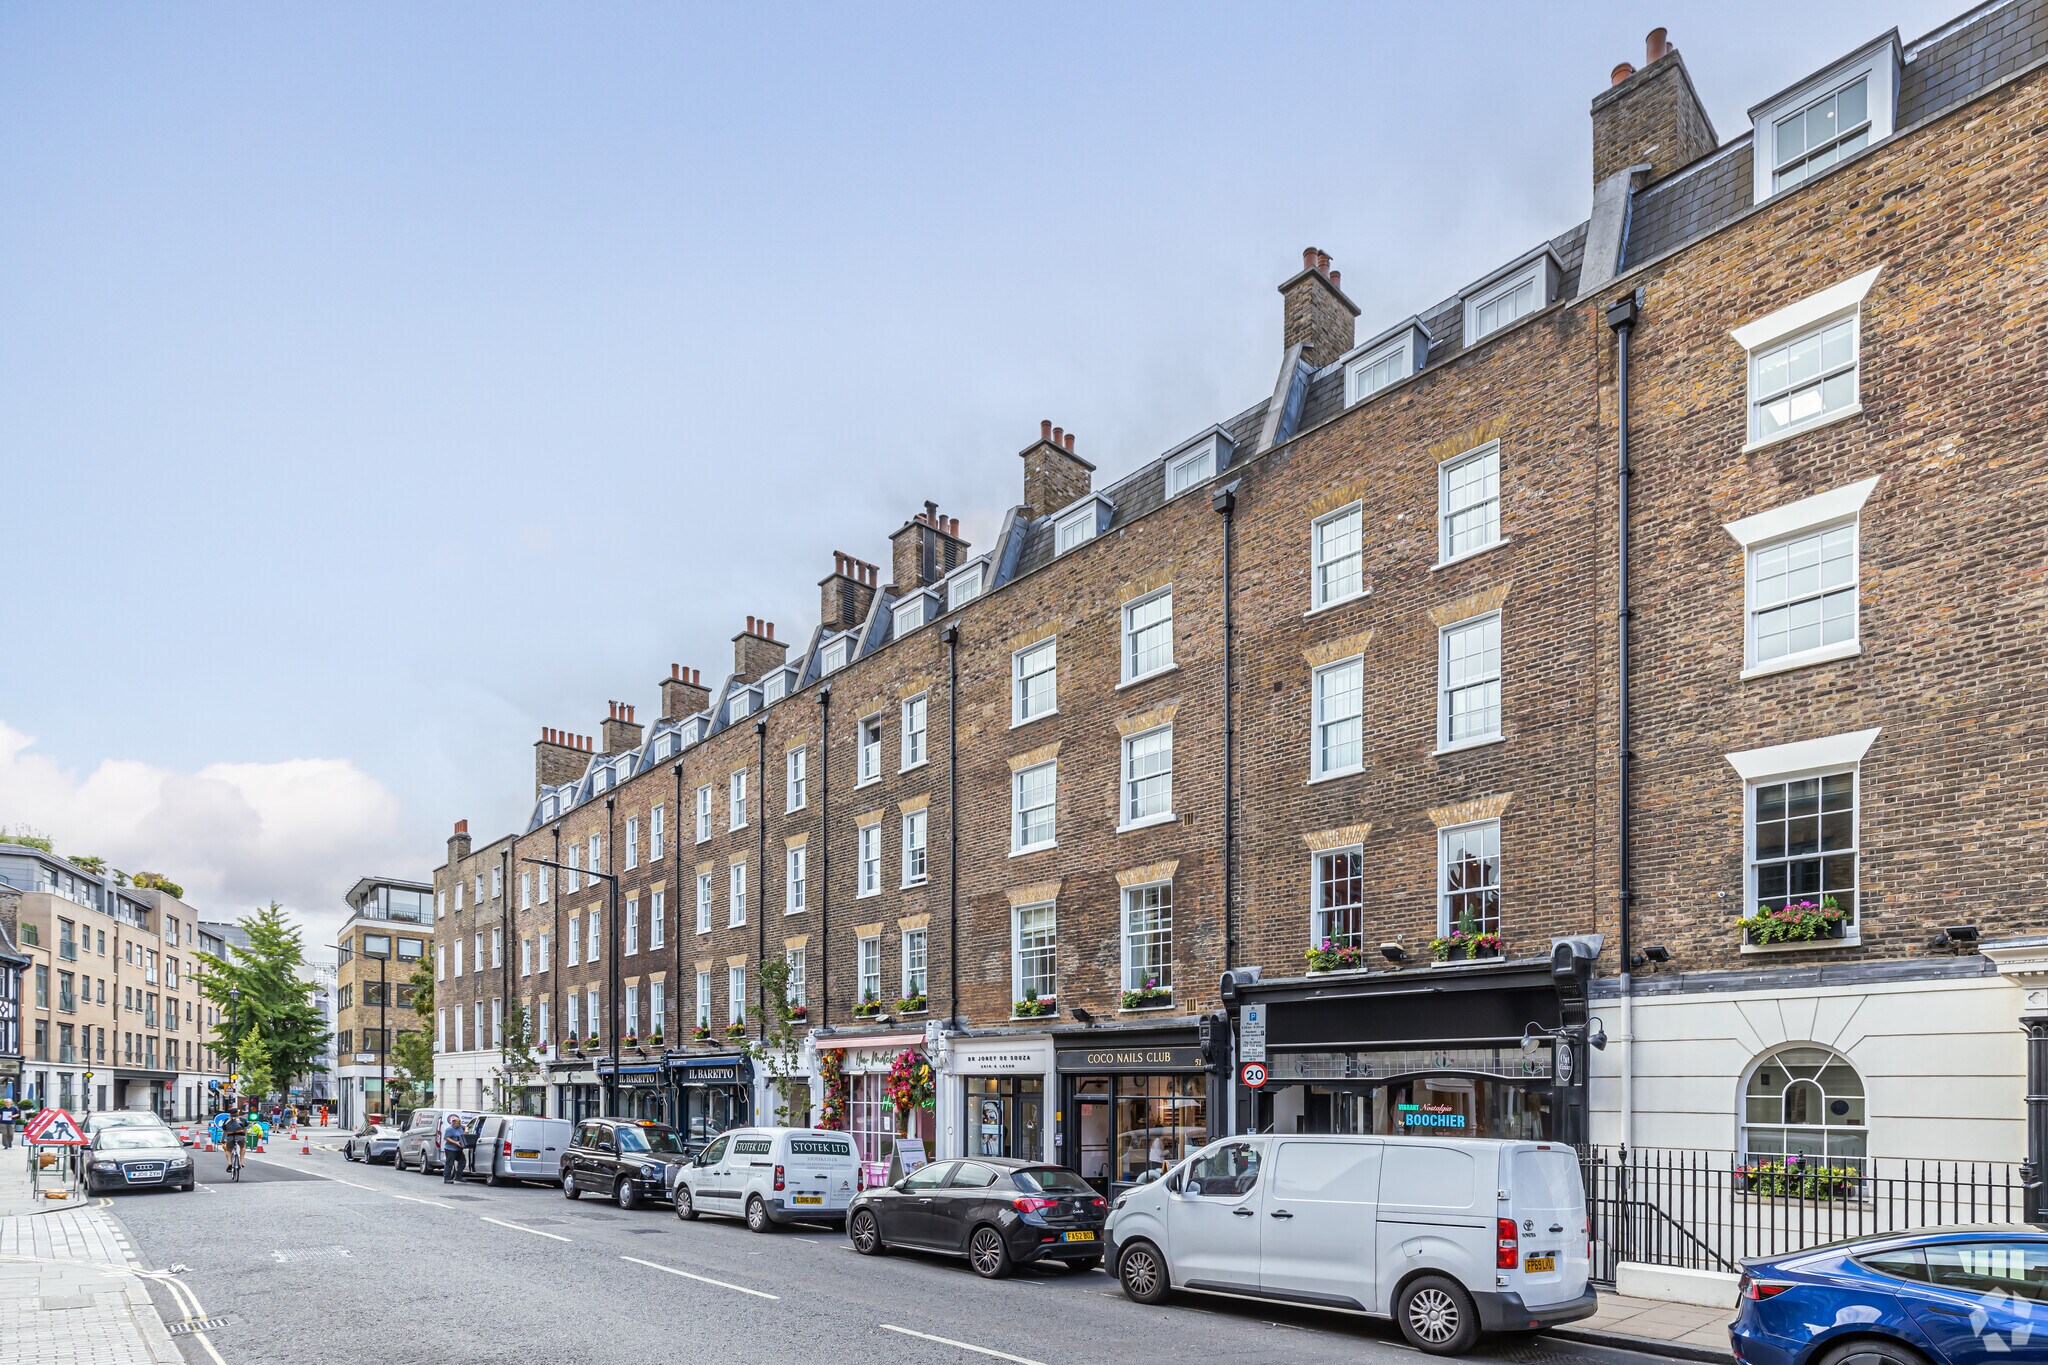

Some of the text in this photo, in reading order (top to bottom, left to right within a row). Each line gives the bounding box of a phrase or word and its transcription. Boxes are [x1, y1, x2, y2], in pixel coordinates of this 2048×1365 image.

[1087, 1052, 1171, 1064] COCO NAILS CLUB
[619, 1074, 655, 1083] IL BARETTO
[689, 1069, 734, 1079] IL BARETTO
[1246, 1070, 1264, 1080] 20
[1420, 1103, 1453, 1114] Nostalgia
[1405, 1114, 1465, 1127] BOOCHIER
[735, 1142, 770, 1152] STOTEK LTD
[793, 1142, 848, 1153] STOTEK LTD
